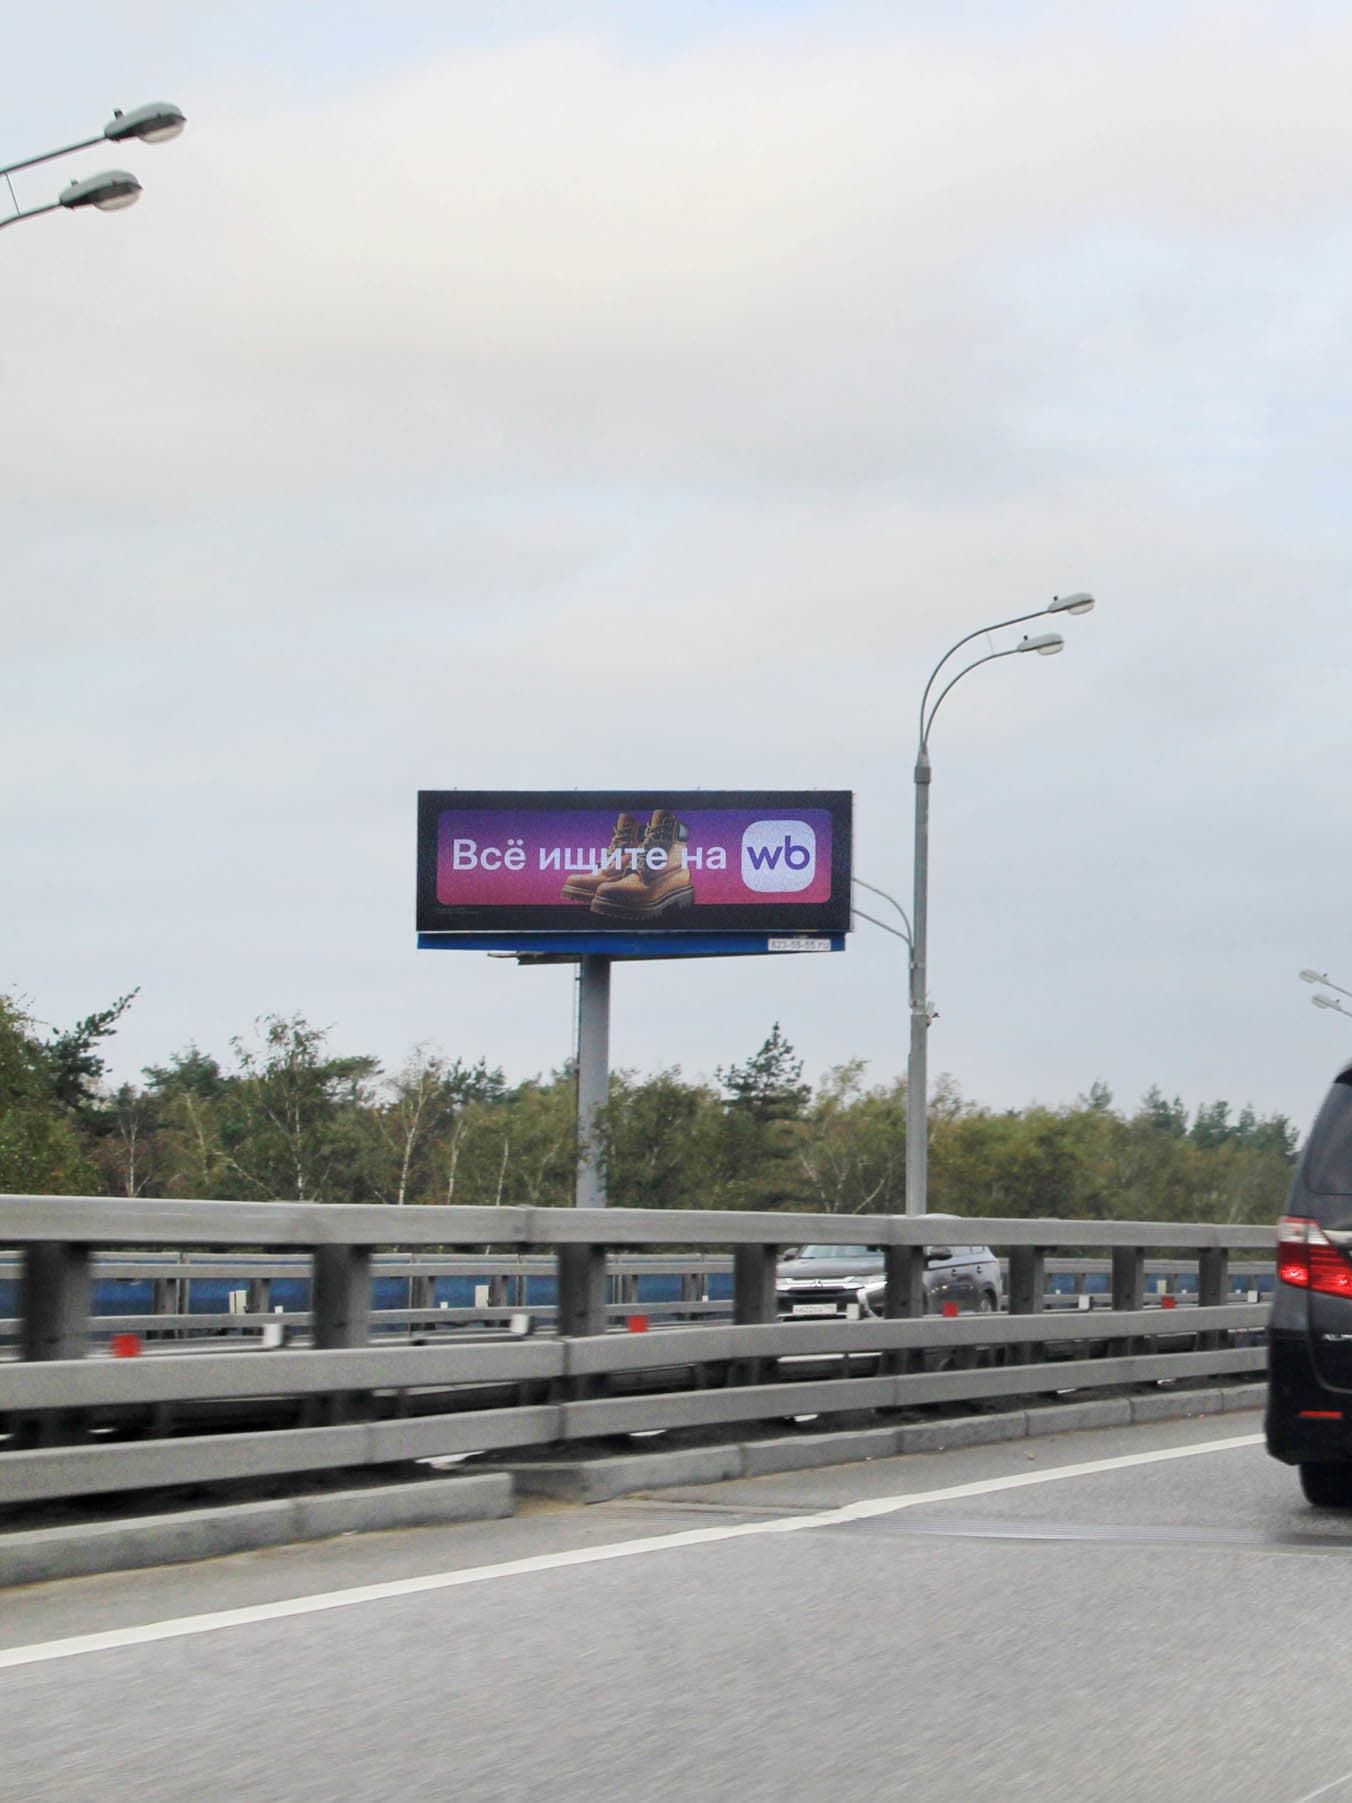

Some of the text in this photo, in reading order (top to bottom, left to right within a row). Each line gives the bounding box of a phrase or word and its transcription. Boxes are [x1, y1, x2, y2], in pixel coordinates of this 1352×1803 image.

[453, 839, 727, 877] Всё ищите на
[747, 835, 810, 870] wb
